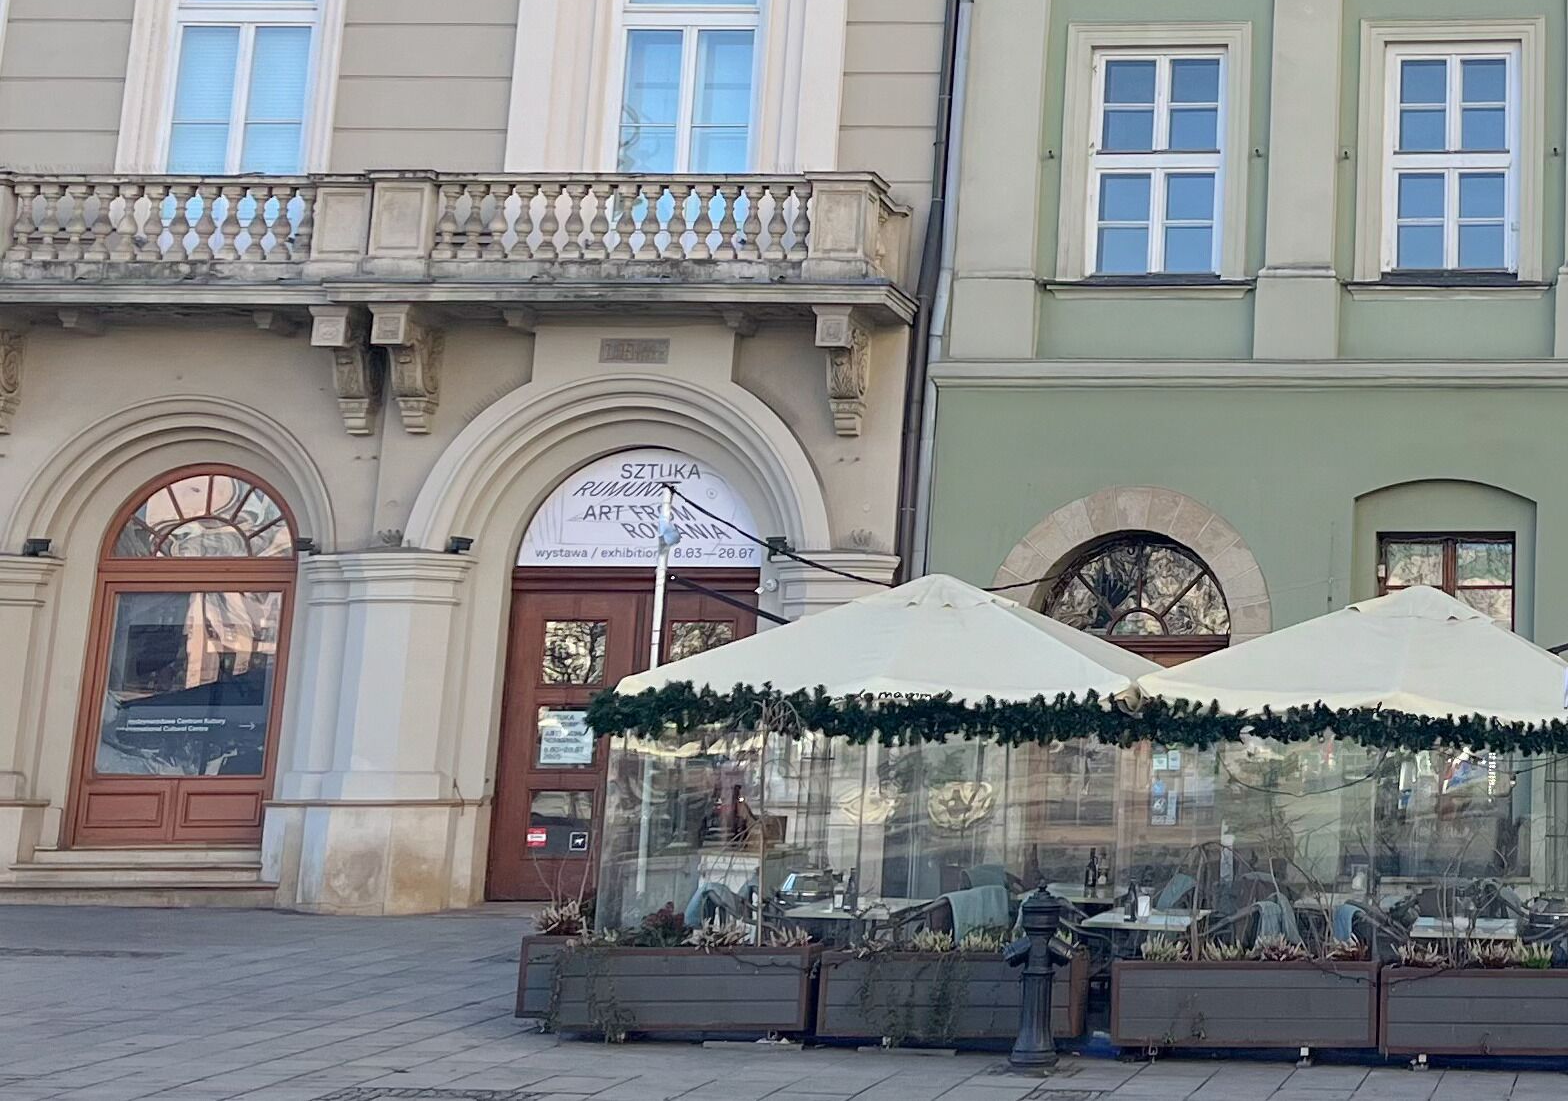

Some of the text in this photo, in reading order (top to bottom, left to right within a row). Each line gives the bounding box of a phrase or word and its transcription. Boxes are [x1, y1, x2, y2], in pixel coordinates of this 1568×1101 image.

[620, 463, 701, 480] SZTUKA
[582, 505, 624, 521] ART
[622, 523, 730, 539] ROANIA
[535, 548, 588, 560] wystawa
